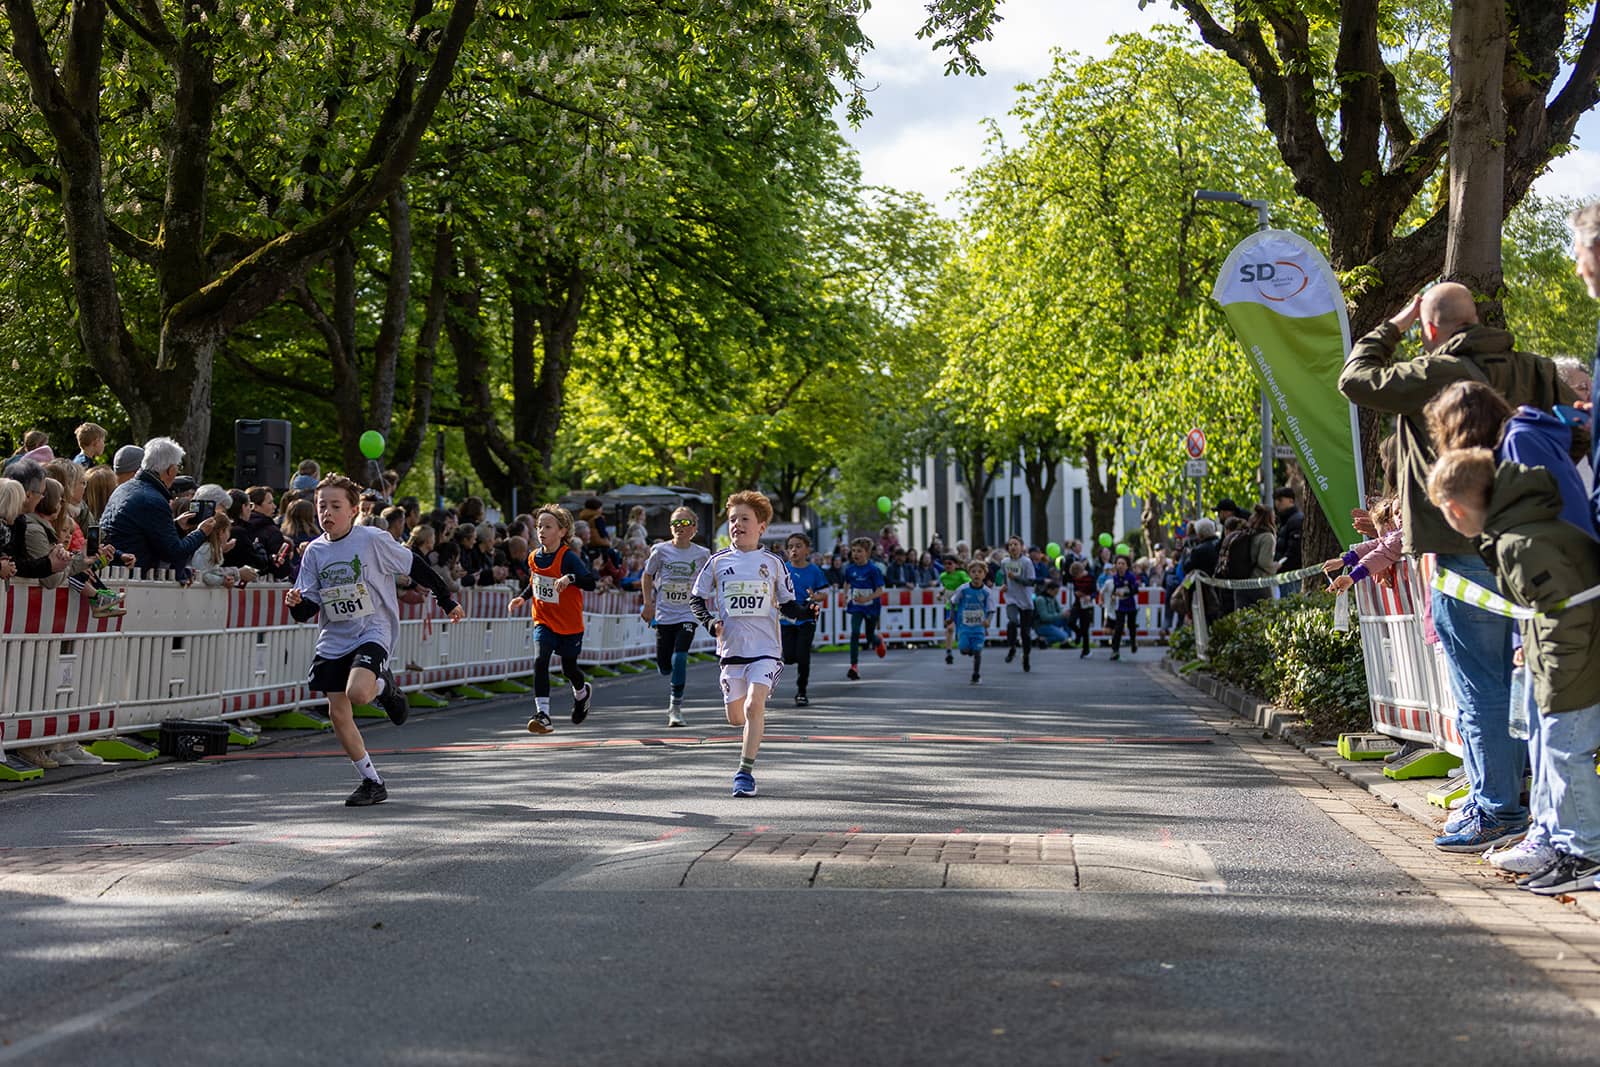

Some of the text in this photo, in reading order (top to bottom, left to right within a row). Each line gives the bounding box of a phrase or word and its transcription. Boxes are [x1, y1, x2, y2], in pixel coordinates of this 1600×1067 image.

[1240, 263, 1275, 282] SD
[1251, 344, 1329, 492] stadtwerke-dinslaken.de
[535, 584, 554, 598] 1193
[666, 591, 688, 600] 1075
[332, 598, 363, 615] 1361
[730, 596, 765, 609] 2097
